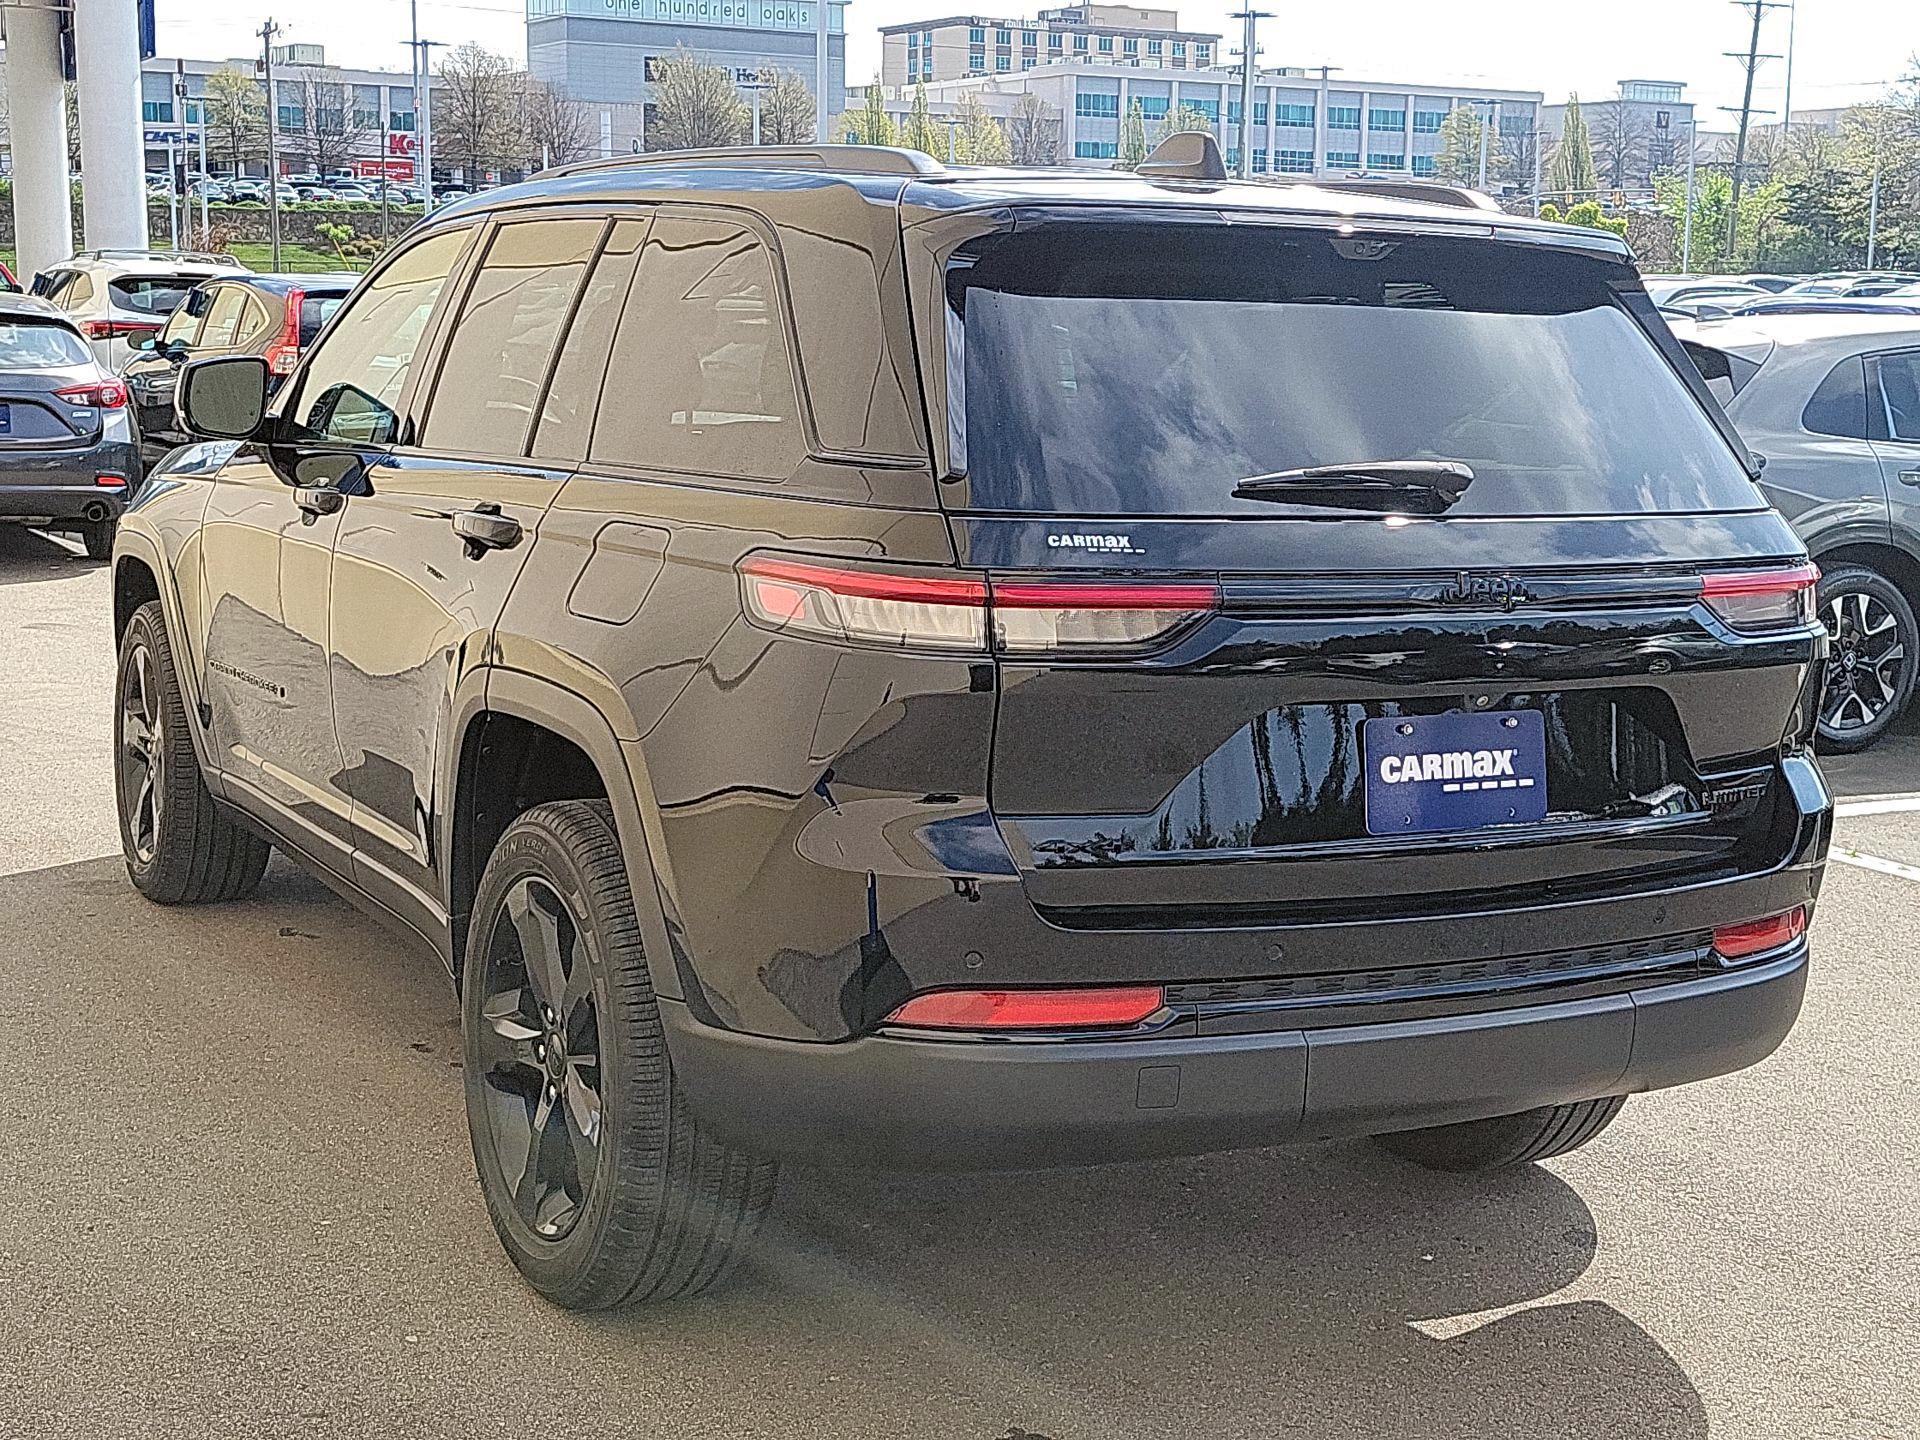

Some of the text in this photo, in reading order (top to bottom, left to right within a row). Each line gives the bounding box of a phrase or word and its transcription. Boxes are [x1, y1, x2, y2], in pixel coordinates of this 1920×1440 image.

[659, 0, 745, 18] hundred
[763, 8, 809, 22] oaks
[1442, 570, 1525, 609] Jeep
